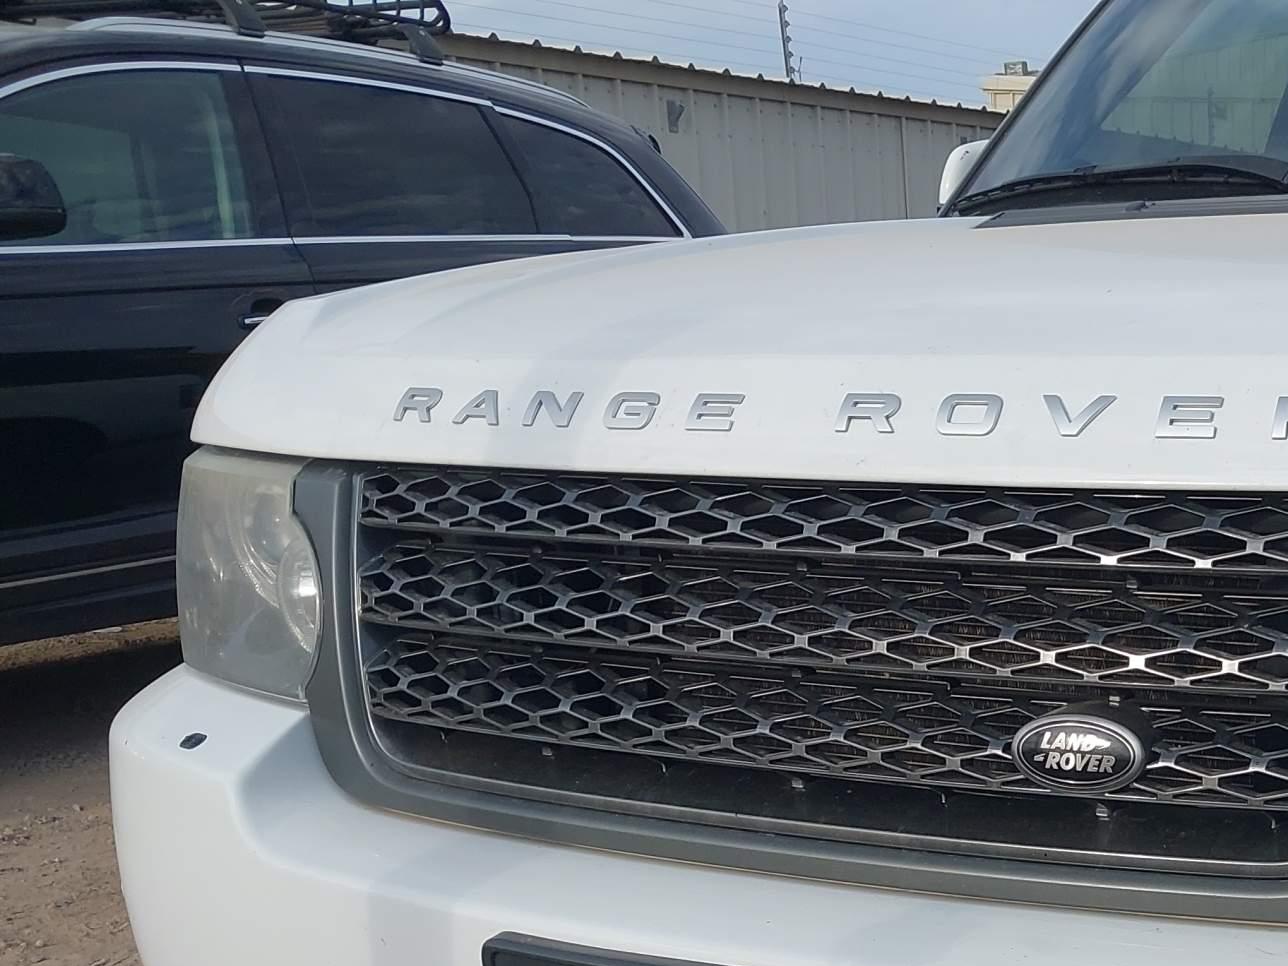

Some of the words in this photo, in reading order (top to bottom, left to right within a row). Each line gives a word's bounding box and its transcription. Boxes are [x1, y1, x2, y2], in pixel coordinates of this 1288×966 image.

[393, 387, 746, 432] RANGE
[1040, 731, 1099, 752] LAND
[1044, 751, 1116, 773] ROVER
